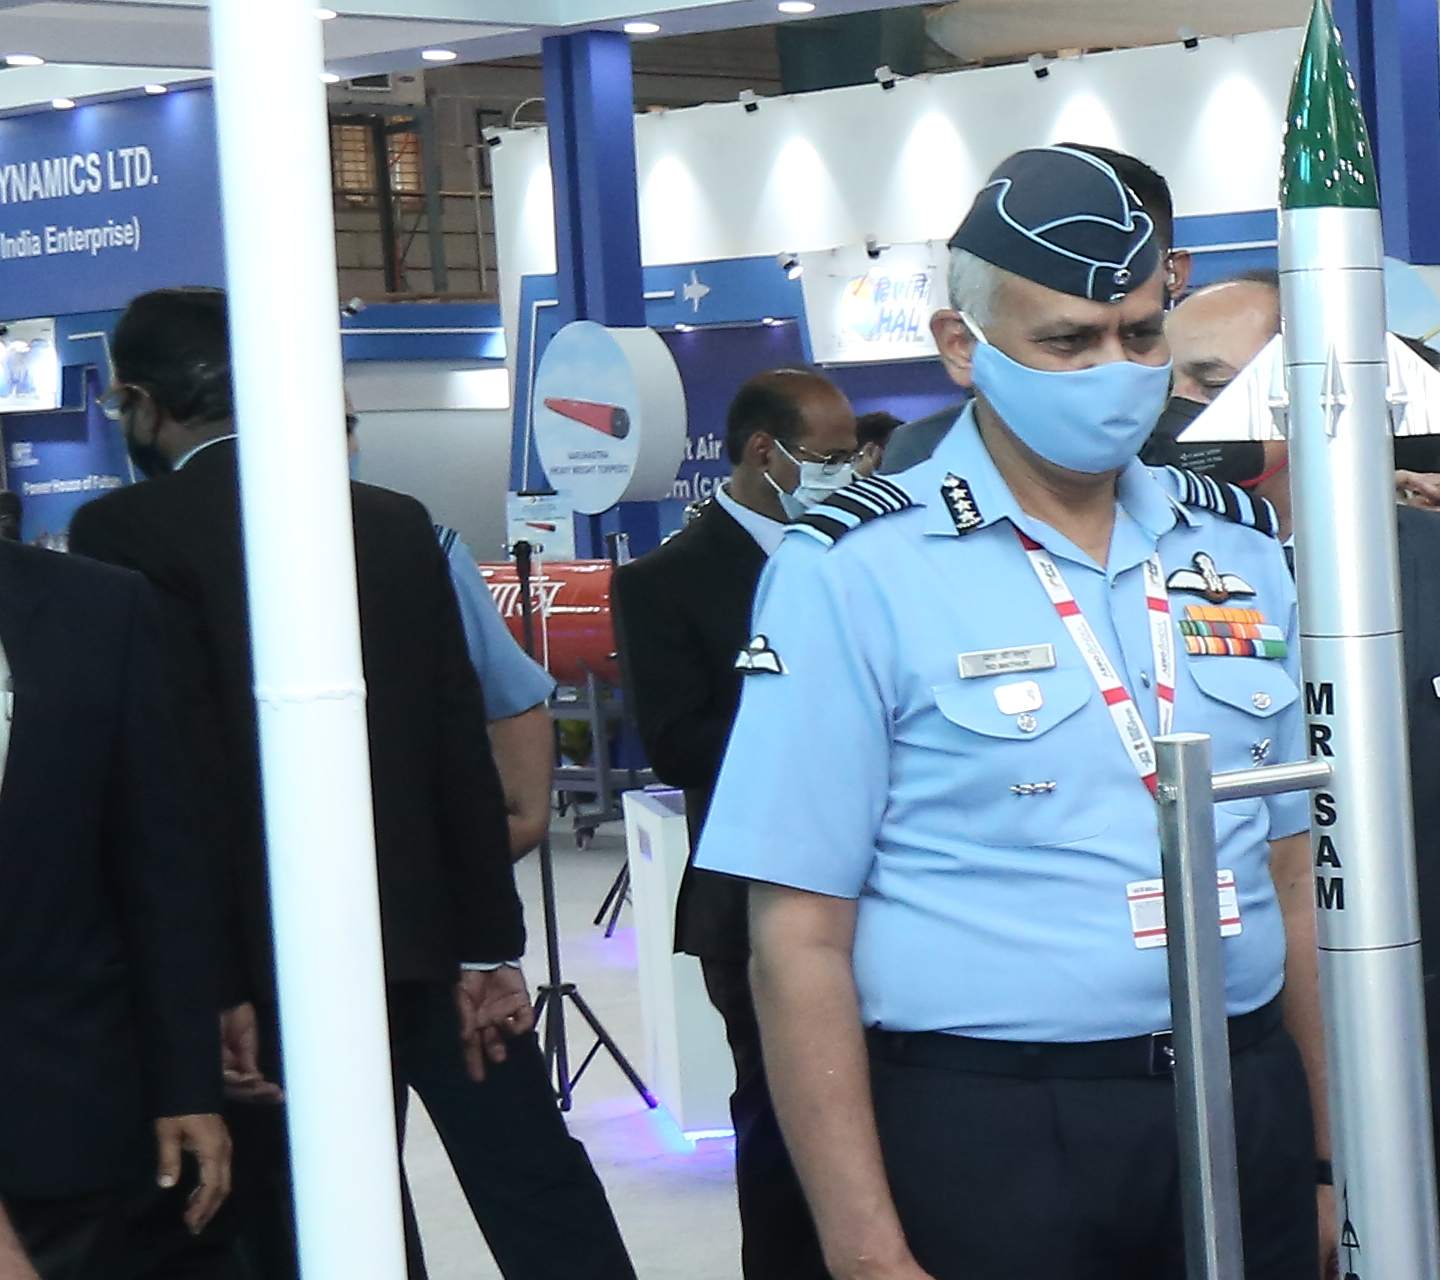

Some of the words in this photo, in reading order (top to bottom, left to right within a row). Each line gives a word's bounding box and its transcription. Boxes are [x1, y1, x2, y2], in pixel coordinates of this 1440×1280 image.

[0, 152, 102, 205] YNAMICS
[107, 145, 160, 191] LTD.
[44, 216, 141, 257] Enterprise)
[697, 433, 723, 460] Air
